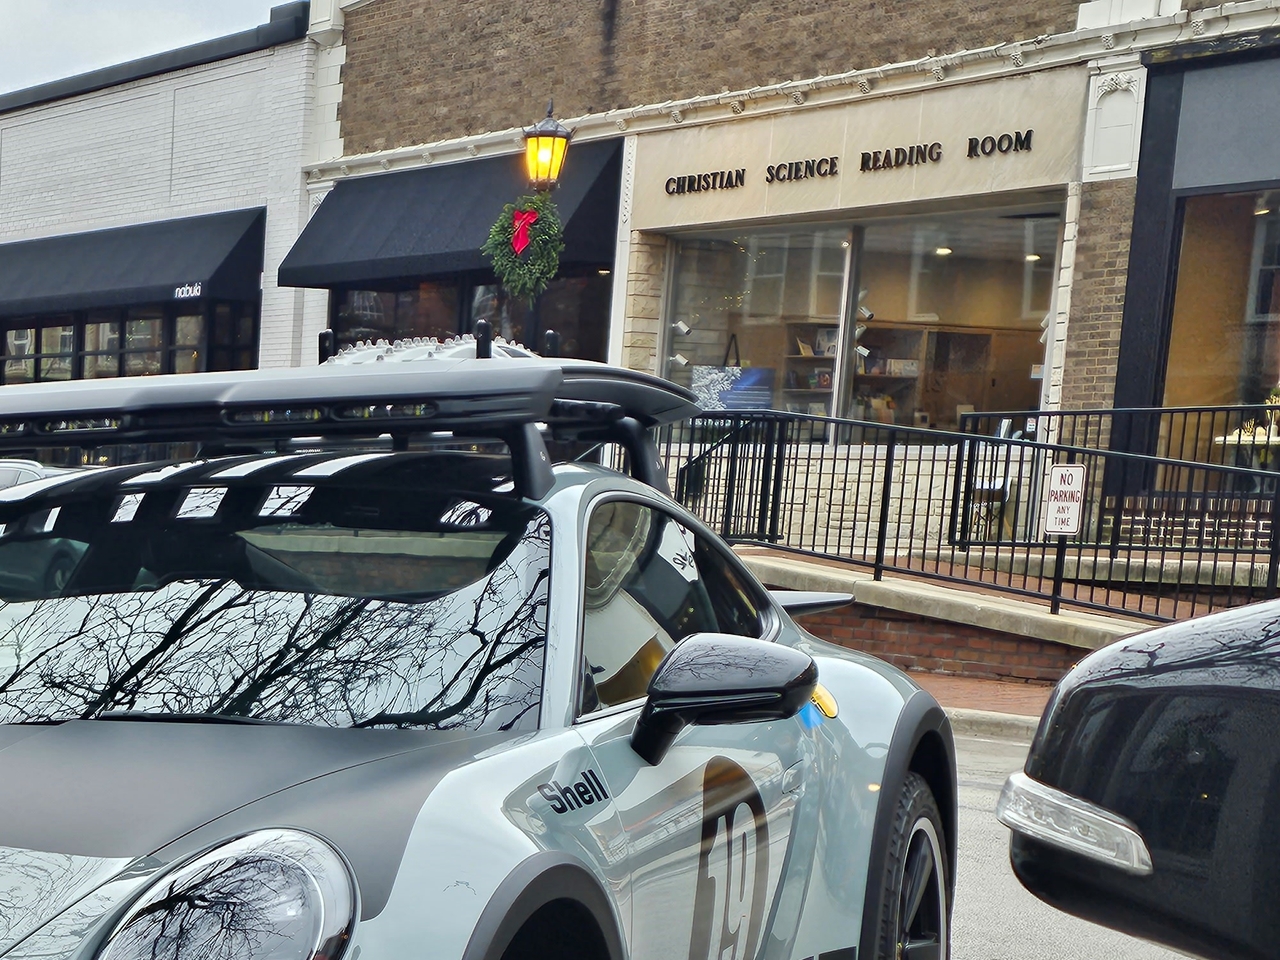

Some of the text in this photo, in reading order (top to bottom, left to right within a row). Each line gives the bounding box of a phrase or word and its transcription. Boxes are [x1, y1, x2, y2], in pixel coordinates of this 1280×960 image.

[664, 129, 1034, 196] CHRISTIAN SCIENCE READING ROOM
[174, 282, 202, 299] nabuki
[1059, 473, 1074, 486] NO
[1049, 489, 1081, 503] PARKING
[1056, 505, 1071, 514] ANY
[1054, 517, 1071, 527] TIME
[540, 769, 610, 816] Shell
